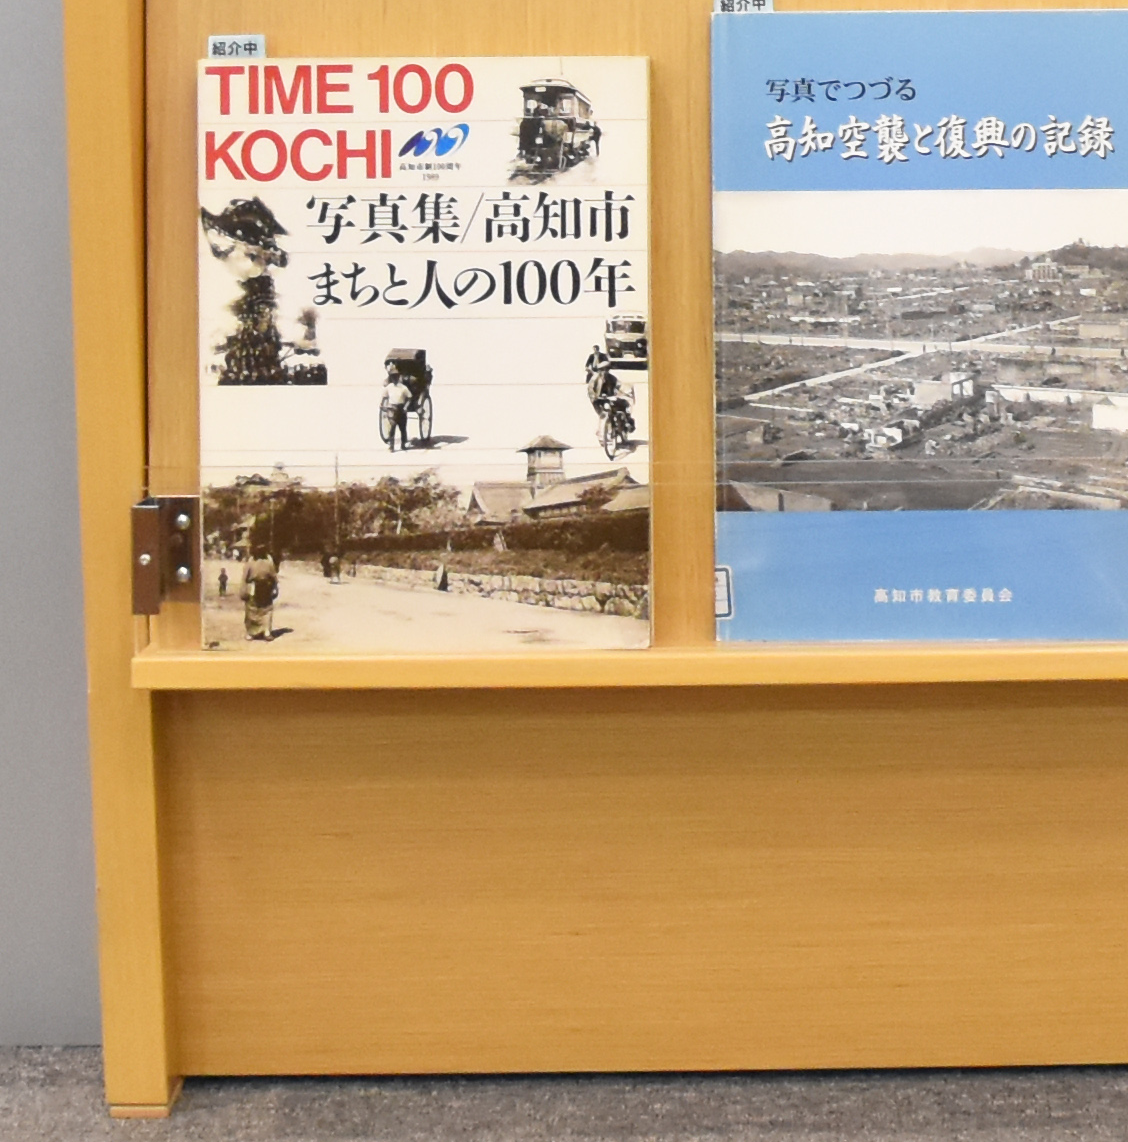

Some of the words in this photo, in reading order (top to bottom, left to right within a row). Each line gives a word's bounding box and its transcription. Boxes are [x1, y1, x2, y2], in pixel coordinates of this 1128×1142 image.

[212, 41, 259, 56] 紹介中
[205, 64, 354, 115] TIME
[367, 63, 474, 114] 100
[765, 77, 917, 103] 写真でつづる
[205, 128, 392, 182] KOCHI
[763, 113, 1116, 163] 高知空襲と復興の記録
[306, 190, 636, 244] 写真集/高知市
[306, 257, 637, 309] まちと人の100年
[873, 587, 1013, 604] 高知市教育委員会
